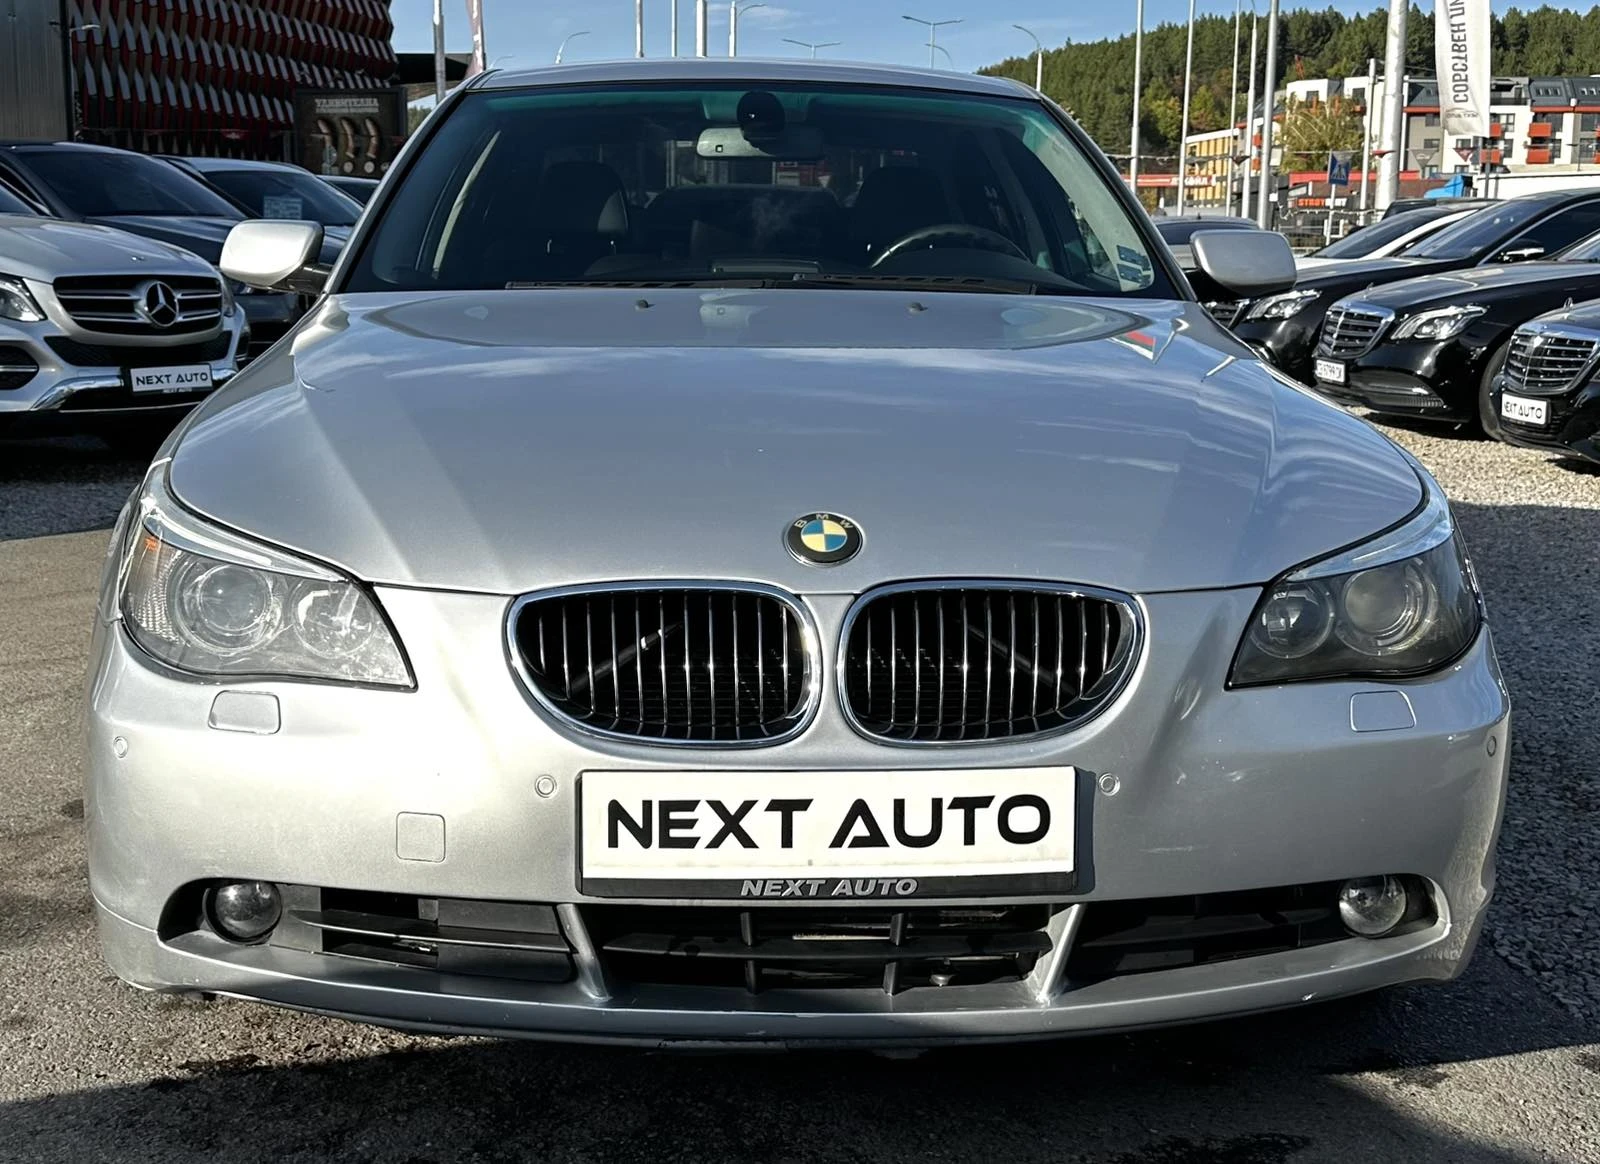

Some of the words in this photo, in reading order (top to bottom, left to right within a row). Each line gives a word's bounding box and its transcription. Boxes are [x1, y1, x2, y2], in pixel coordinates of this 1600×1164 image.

[136, 374, 172, 386] NEXT
[176, 372, 209, 383] AUTO
[1518, 405, 1542, 419] AUTO
[794, 513, 853, 529] BMW
[608, 798, 814, 849] NEXT
[828, 794, 1051, 849] AUTO
[740, 879, 826, 897] NEXT
[831, 878, 918, 896] AUTO
